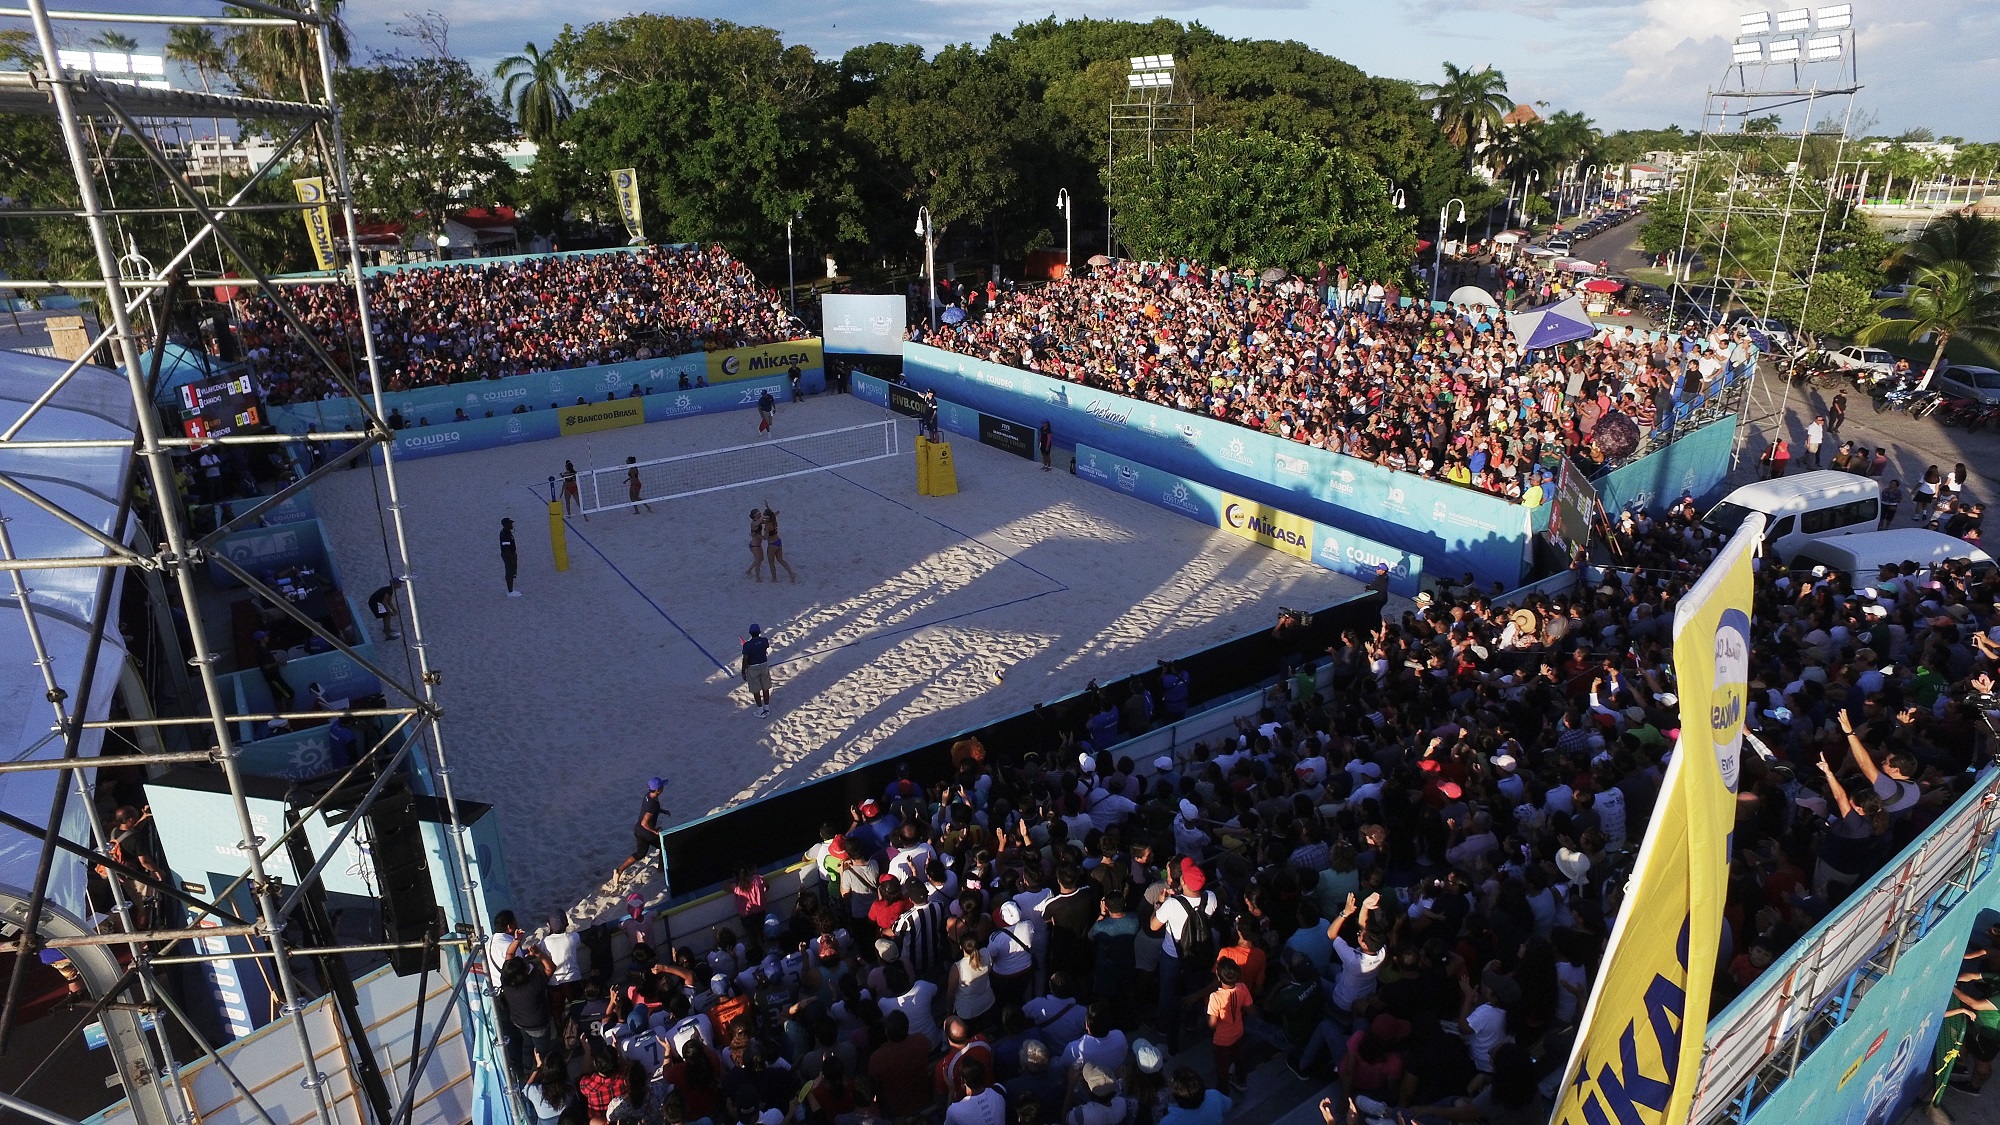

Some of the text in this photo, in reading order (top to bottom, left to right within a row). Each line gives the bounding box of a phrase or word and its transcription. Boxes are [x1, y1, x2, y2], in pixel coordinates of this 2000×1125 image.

[748, 350, 810, 371] MIKASA
[666, 364, 697, 375] MOVEO
[986, 374, 1014, 388] COJUDEQ
[483, 388, 528, 400] COJUDEQ
[578, 408, 638, 424] BANCO DO BRASIL
[1085, 400, 1134, 425] Chetumal
[405, 431, 460, 448] COJUDEQ
[1248, 514, 1306, 549] MIKASA
[644, 1042, 660, 1066] 7
